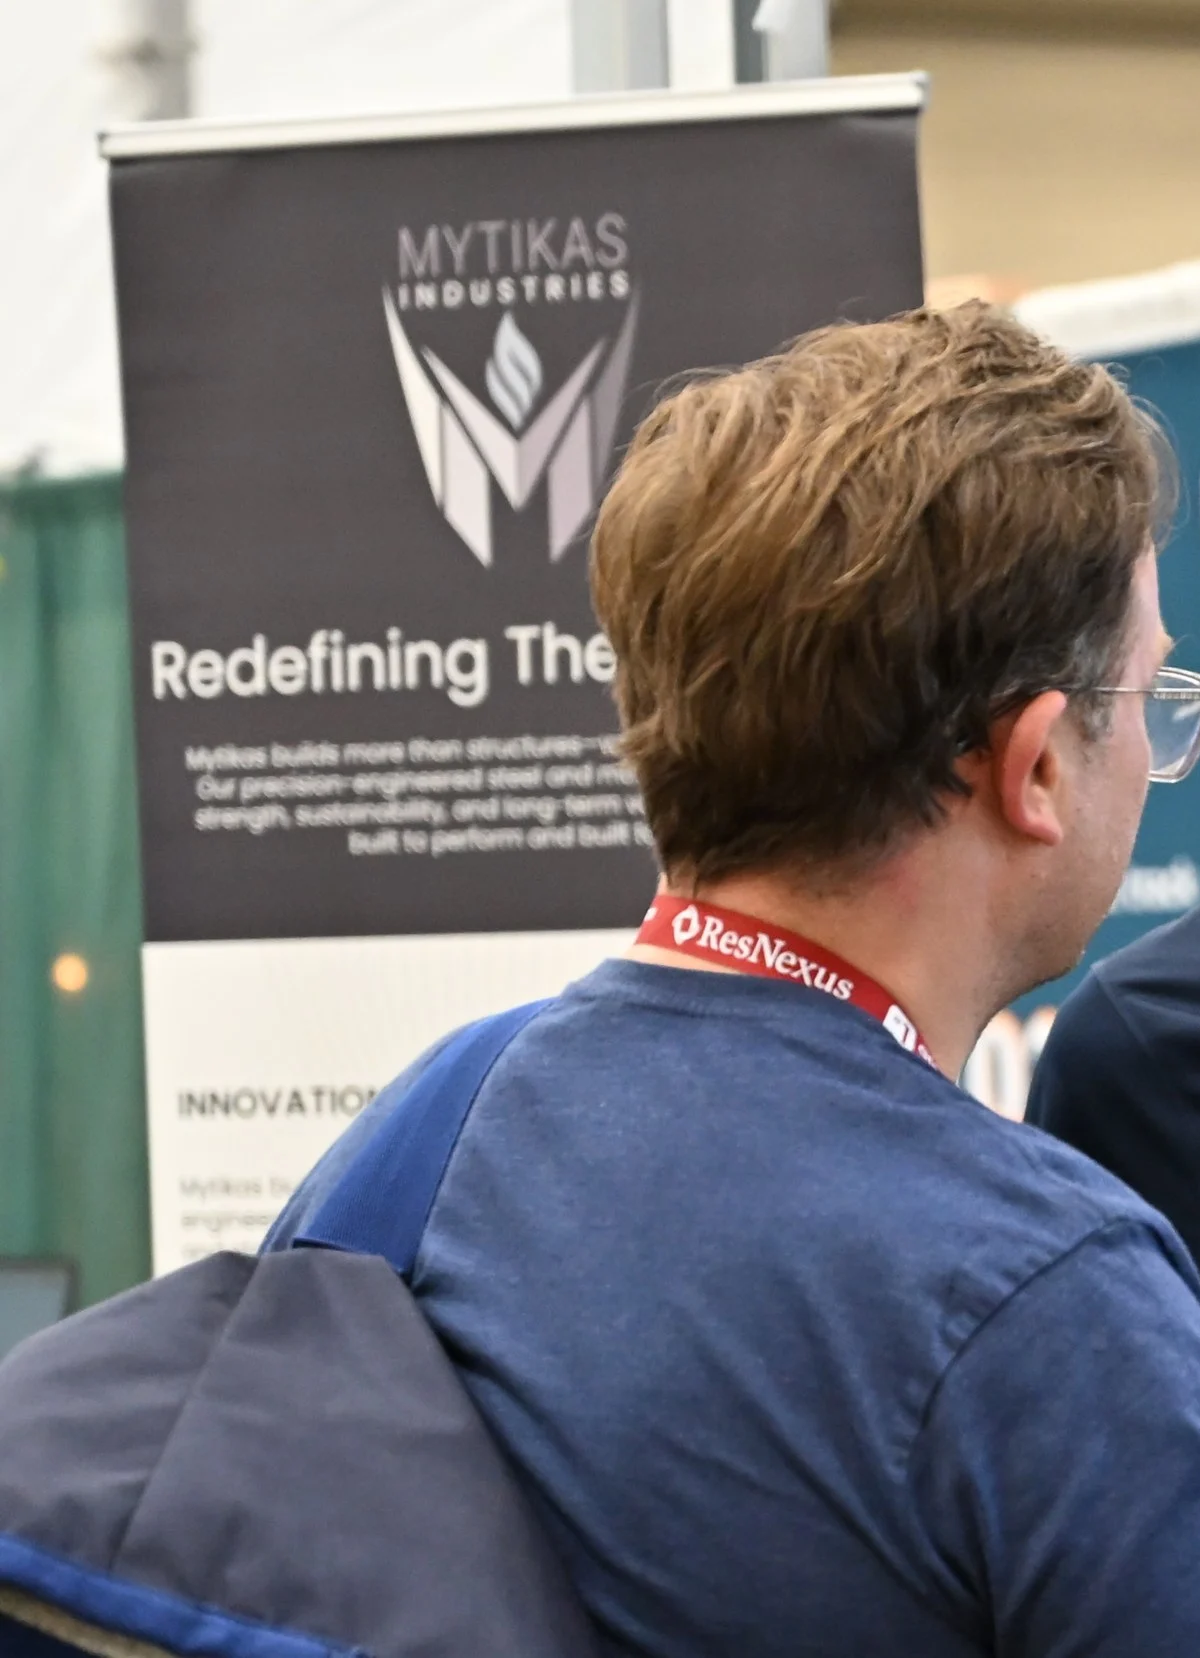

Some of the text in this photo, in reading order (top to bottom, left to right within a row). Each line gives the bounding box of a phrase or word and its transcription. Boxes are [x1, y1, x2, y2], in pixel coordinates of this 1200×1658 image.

[398, 213, 629, 277] MYTIKAS
[399, 269, 630, 310] INDUSTRIES
[152, 621, 618, 708] Redefining The
[696, 915, 855, 1000] ResNexus
